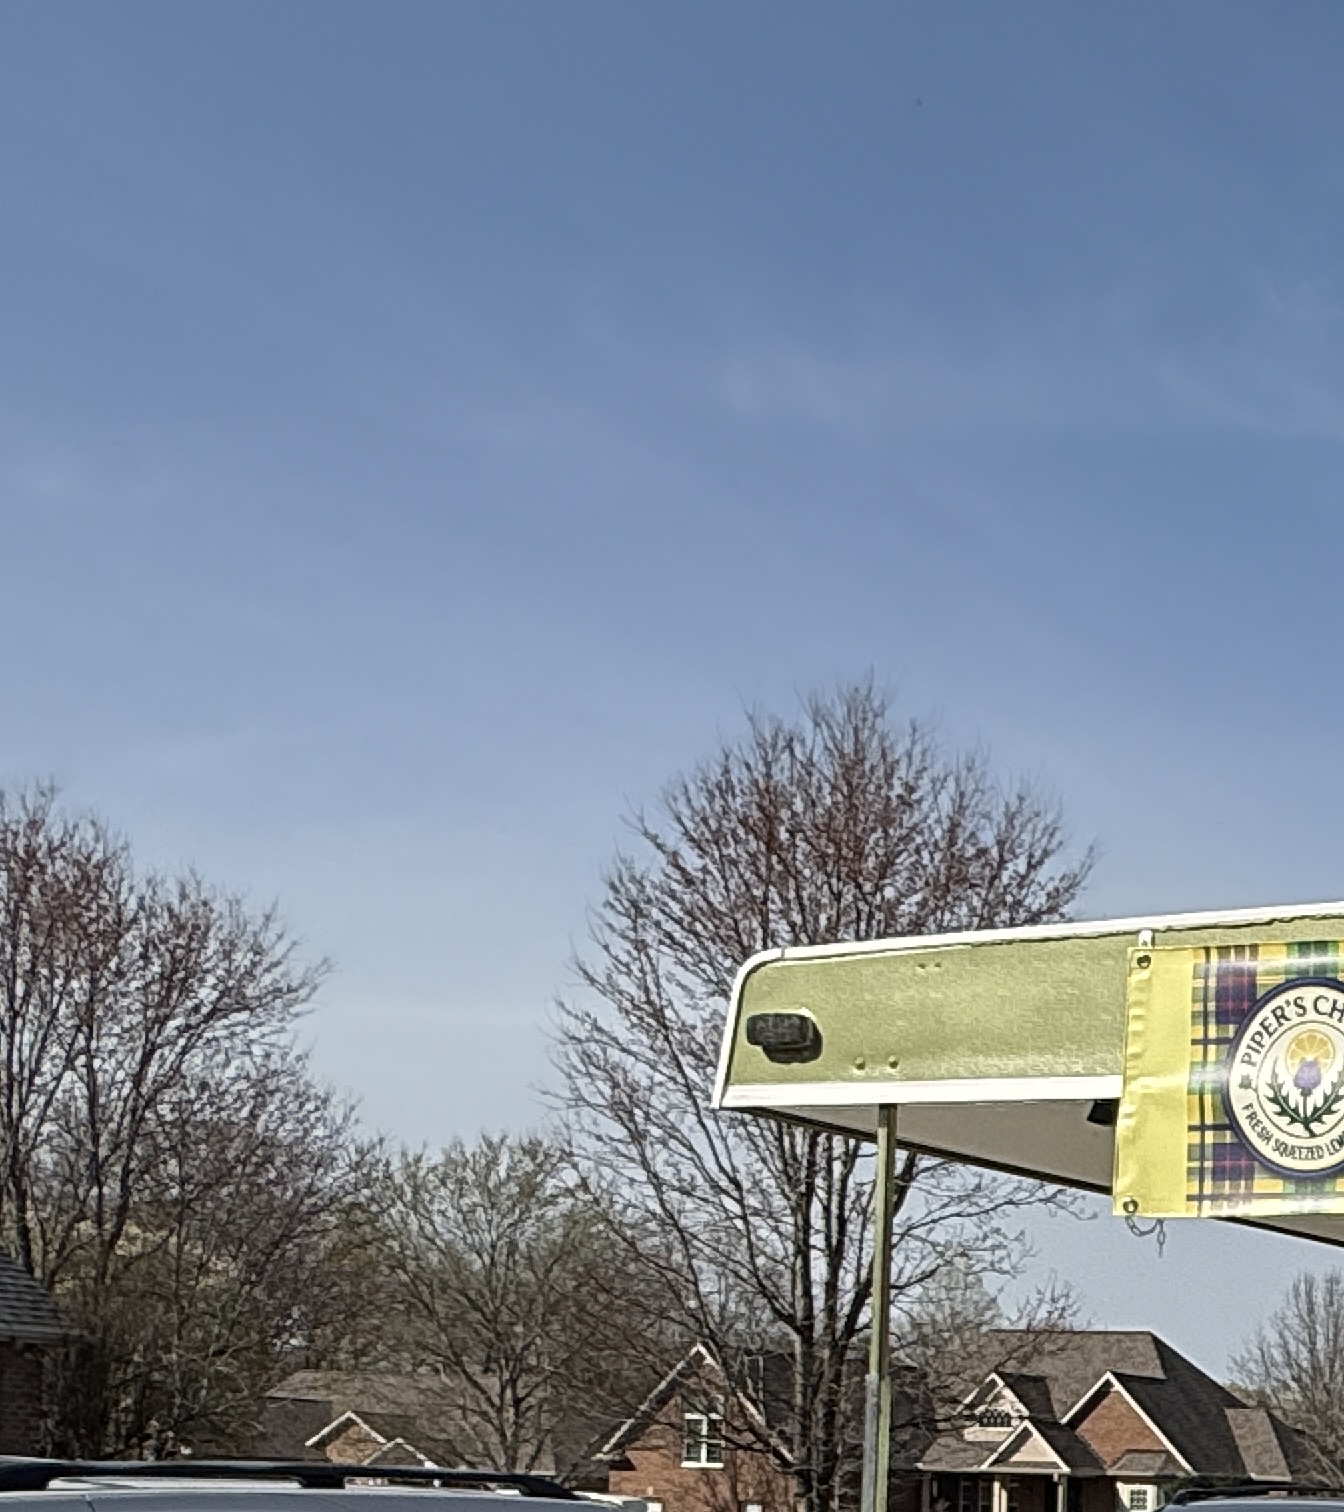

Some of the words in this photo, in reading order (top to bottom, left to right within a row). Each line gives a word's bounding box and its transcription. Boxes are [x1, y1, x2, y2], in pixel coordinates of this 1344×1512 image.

[1240, 996, 1308, 1068] PIPER'S
[1241, 1101, 1275, 1146] FRESH
[1271, 1140, 1325, 1161] SQUEEZED
